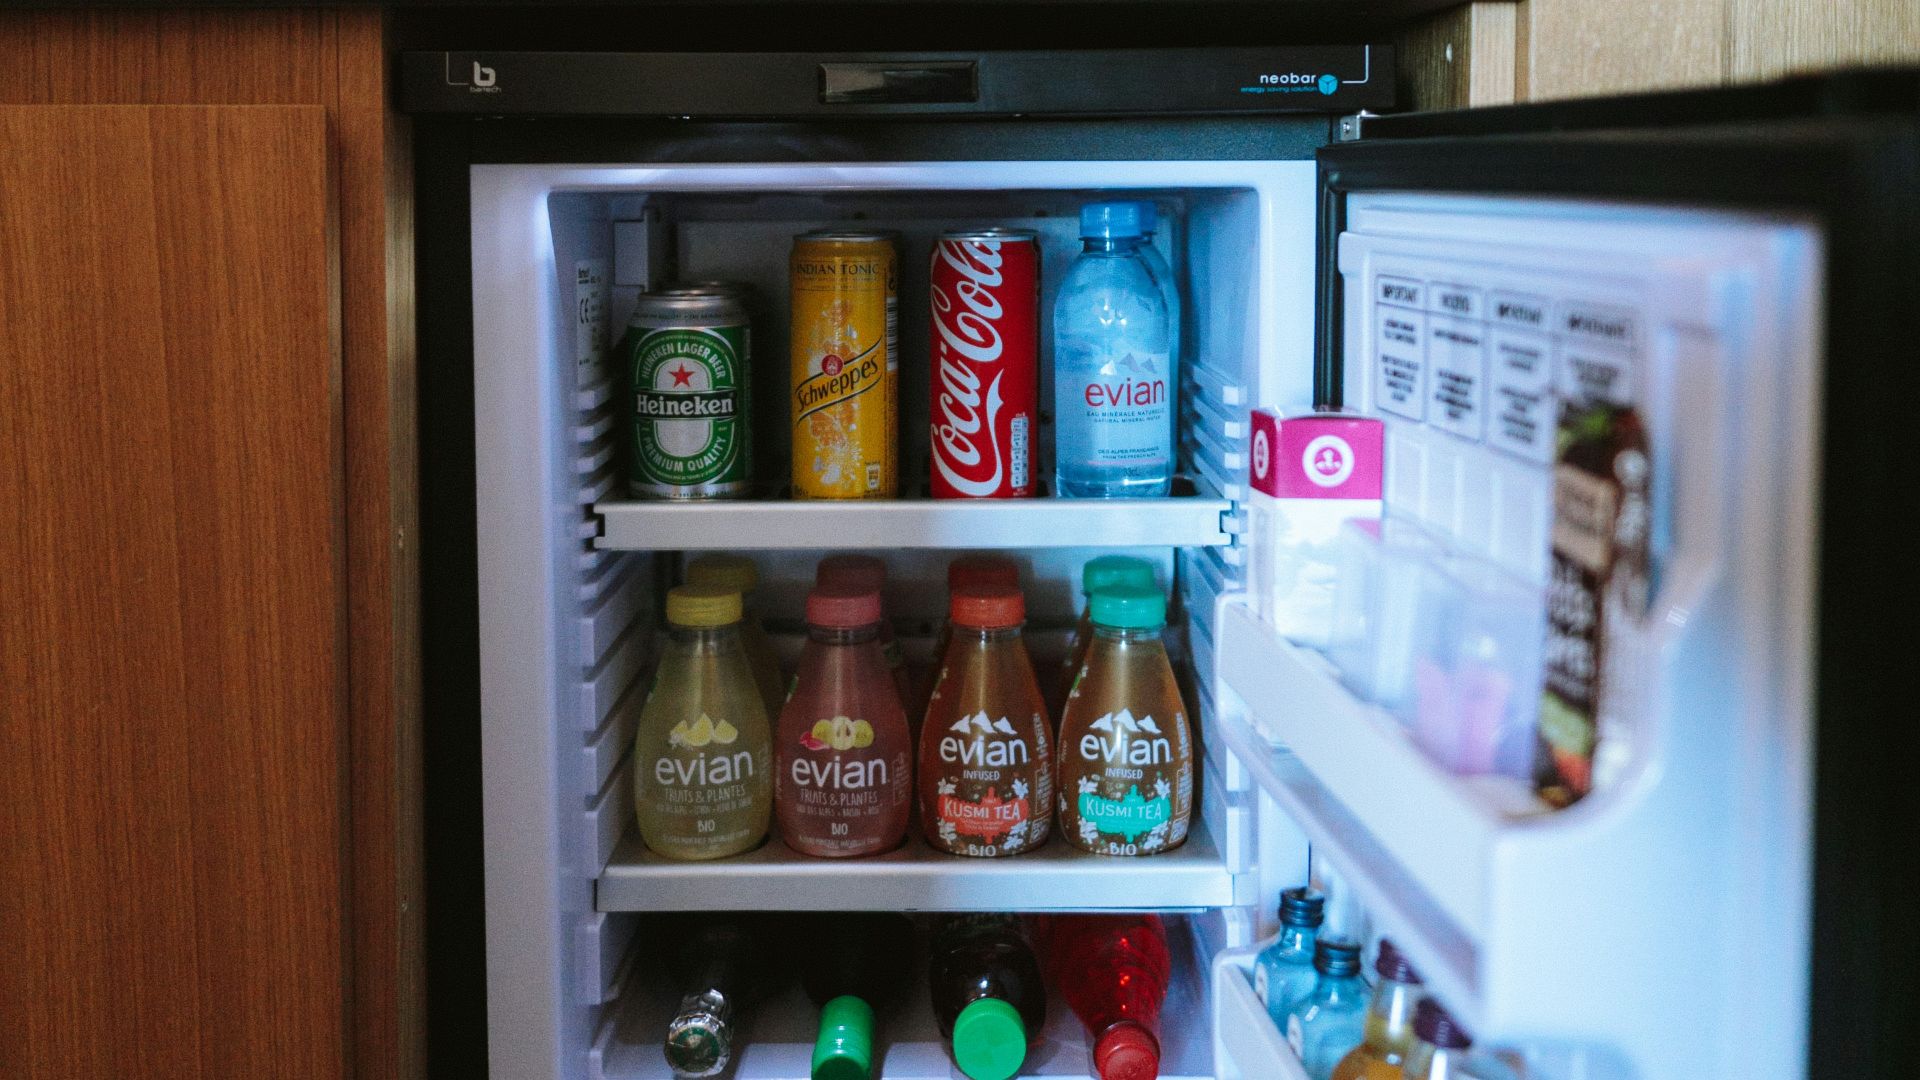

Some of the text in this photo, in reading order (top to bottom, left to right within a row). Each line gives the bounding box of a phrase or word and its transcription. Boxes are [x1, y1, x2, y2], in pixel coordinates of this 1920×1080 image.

[1260, 72, 1317, 84] neobar
[1240, 86, 1265, 94] energy
[1266, 86, 1290, 94] saving
[797, 263, 880, 275] INDIAN TONIC
[641, 342, 726, 379] HEINEKEN LAGER BEER
[931, 241, 1003, 496] Coca-Cola
[797, 354, 879, 412] Schweppes
[1084, 377, 1165, 407] evian
[636, 394, 734, 417] Heineken
[642, 436, 727, 472] PREMIUM QUALITY
[939, 734, 1028, 767] evian
[1080, 733, 1171, 766] evian
[655, 751, 753, 786] evian
[791, 755, 888, 789] evian
[963, 770, 1000, 781] INFUSED
[1105, 768, 1143, 779] INFUSED
[665, 785, 746, 803] FRUITS & PLANTES
[800, 788, 878, 807] FRUITS & PLANTES
[944, 798, 1021, 820] KUSMI TEA
[1086, 797, 1162, 820] KUSMI TEA
[697, 819, 716, 833] BIO
[831, 822, 849, 836] BIO
[968, 844, 997, 857] BIO
[1109, 842, 1137, 856] BIO
